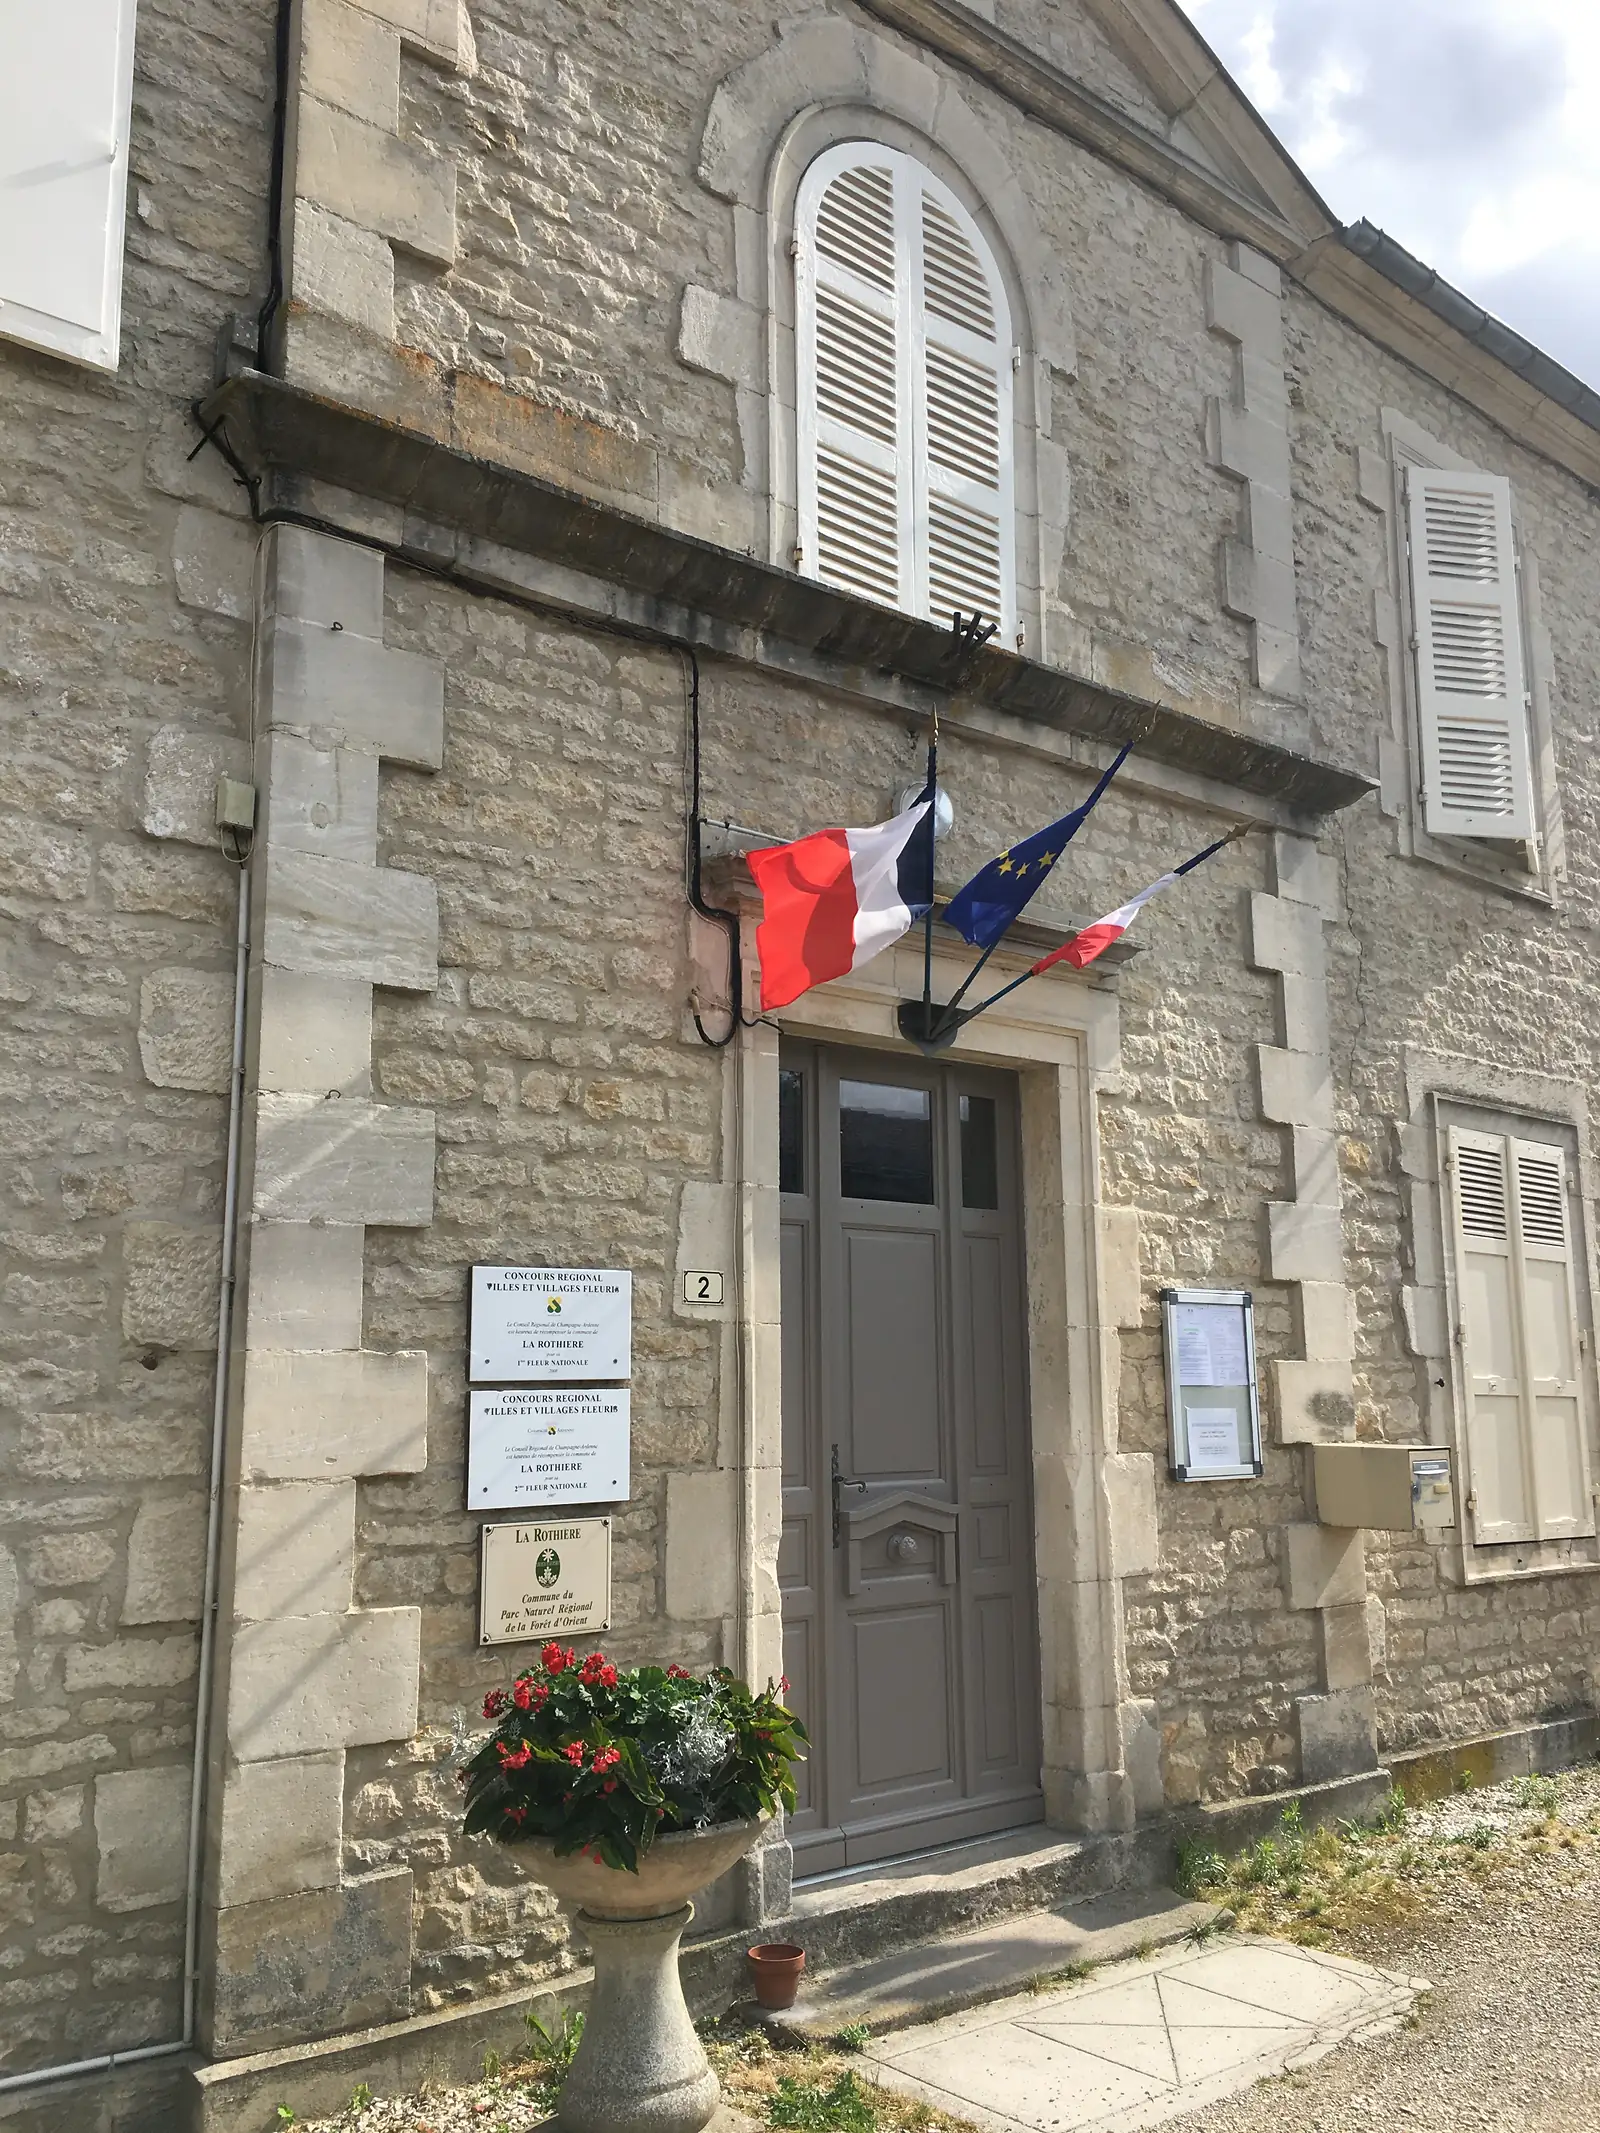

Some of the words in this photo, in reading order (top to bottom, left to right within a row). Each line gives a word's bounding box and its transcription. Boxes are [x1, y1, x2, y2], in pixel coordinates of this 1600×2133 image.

[504, 1272, 555, 1281] CONCOURS
[558, 1273, 603, 1282] REGIONAL
[523, 1283, 534, 1292] ET
[536, 1284, 581, 1293] VILLAGES
[698, 1276, 710, 1298] 2
[523, 1340, 535, 1348] LA
[538, 1340, 584, 1348] ROTHIERE
[502, 1395, 553, 1404] CONCOURS
[556, 1394, 602, 1403] REGIONAL
[521, 1406, 532, 1415] ET
[534, 1406, 579, 1415] VILLAGES
[521, 1465, 533, 1473] LA
[536, 1462, 583, 1472] ROTHIERE
[550, 1482, 587, 1490] NATIONALE
[522, 1593, 561, 1604] Commune
[563, 1590, 574, 1599] du
[500, 1610, 519, 1620] Parc
[524, 1605, 555, 1618] Naturel
[558, 1601, 593, 1614] Régional
[505, 1623, 516, 1633] de
[517, 1622, 526, 1632] la
[530, 1620, 551, 1630] Forêt
[553, 1616, 588, 1627] d'Orient
